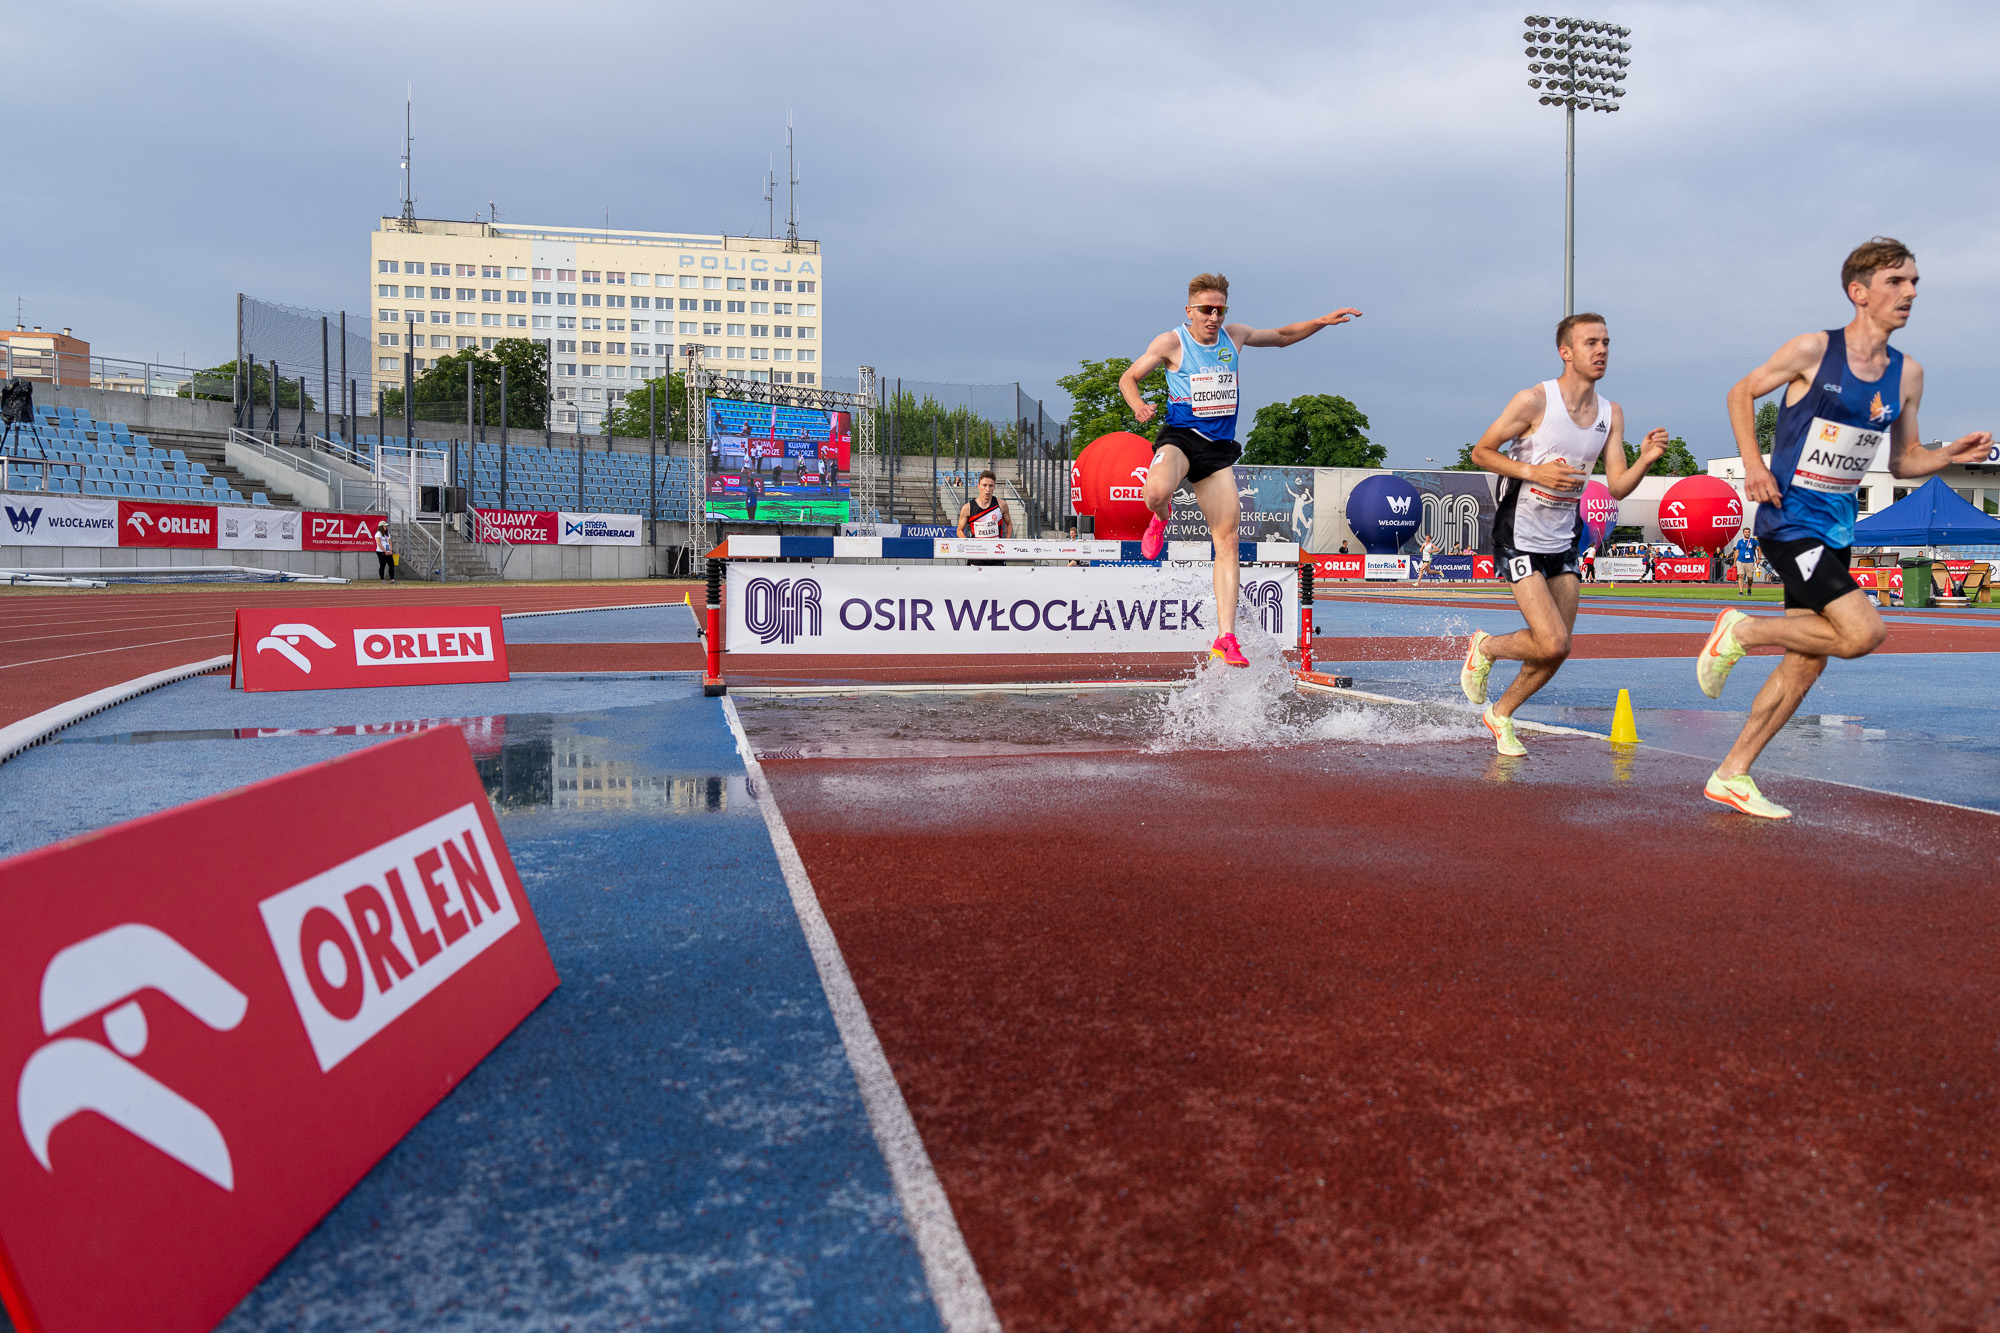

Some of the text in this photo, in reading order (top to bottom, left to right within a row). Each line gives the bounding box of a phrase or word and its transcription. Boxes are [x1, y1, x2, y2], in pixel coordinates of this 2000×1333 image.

[679, 255, 815, 274] POLICJA
[1218, 374, 1233, 383] 372
[1193, 389, 1236, 402] CZECHOWICZ
[1855, 434, 1878, 447] 194
[1807, 449, 1869, 471] ANTOSZ
[1112, 488, 1143, 499] ORLE
[484, 512, 537, 526] KUJAWY
[1240, 512, 1290, 523] EKREACJI
[1587, 511, 1618, 522] POMO
[1714, 517, 1741, 526] ORLEN
[48, 517, 114, 529] WŁOCŁAWEK
[158, 516, 210, 534] ORLEN
[312, 518, 373, 539] PZLA
[585, 521, 607, 529] STREFA
[1660, 519, 1685, 528] ORLEN
[483, 527, 548, 541] POMORZE
[585, 529, 635, 538] REGENERACJI
[907, 527, 947, 537] KUJAWY
[1324, 561, 1360, 571] ORLEN
[1367, 561, 1397, 569] InterRisk
[1515, 558, 1527, 577] 6
[1674, 564, 1705, 574] ORLEN
[839, 598, 936, 631] OSIR
[944, 598, 1205, 632] WŁOCŁAWEK
[363, 632, 485, 660] ORLEN
[299, 828, 502, 1022] ORLEN
